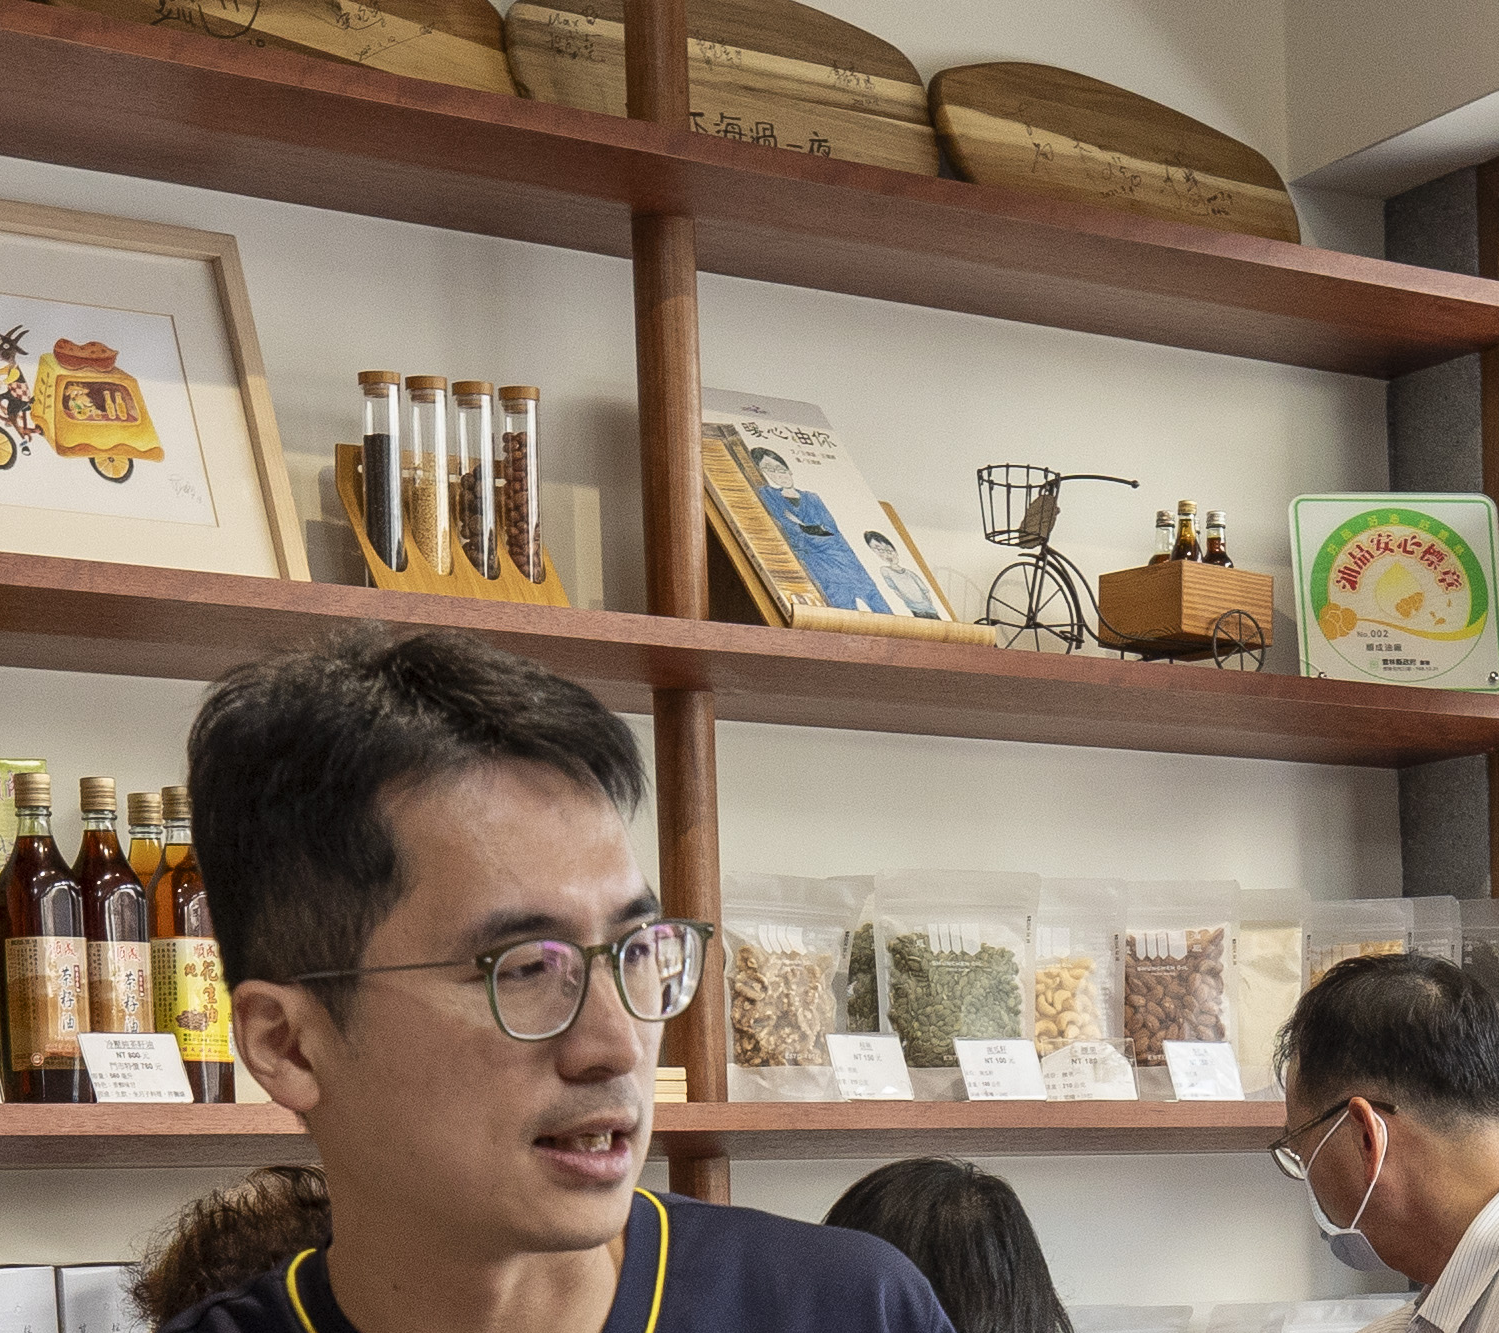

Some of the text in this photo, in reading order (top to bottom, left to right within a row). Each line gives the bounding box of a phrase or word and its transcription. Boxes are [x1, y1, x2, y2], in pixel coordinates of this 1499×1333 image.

[1335, 533, 1463, 591] 油品安心標章
